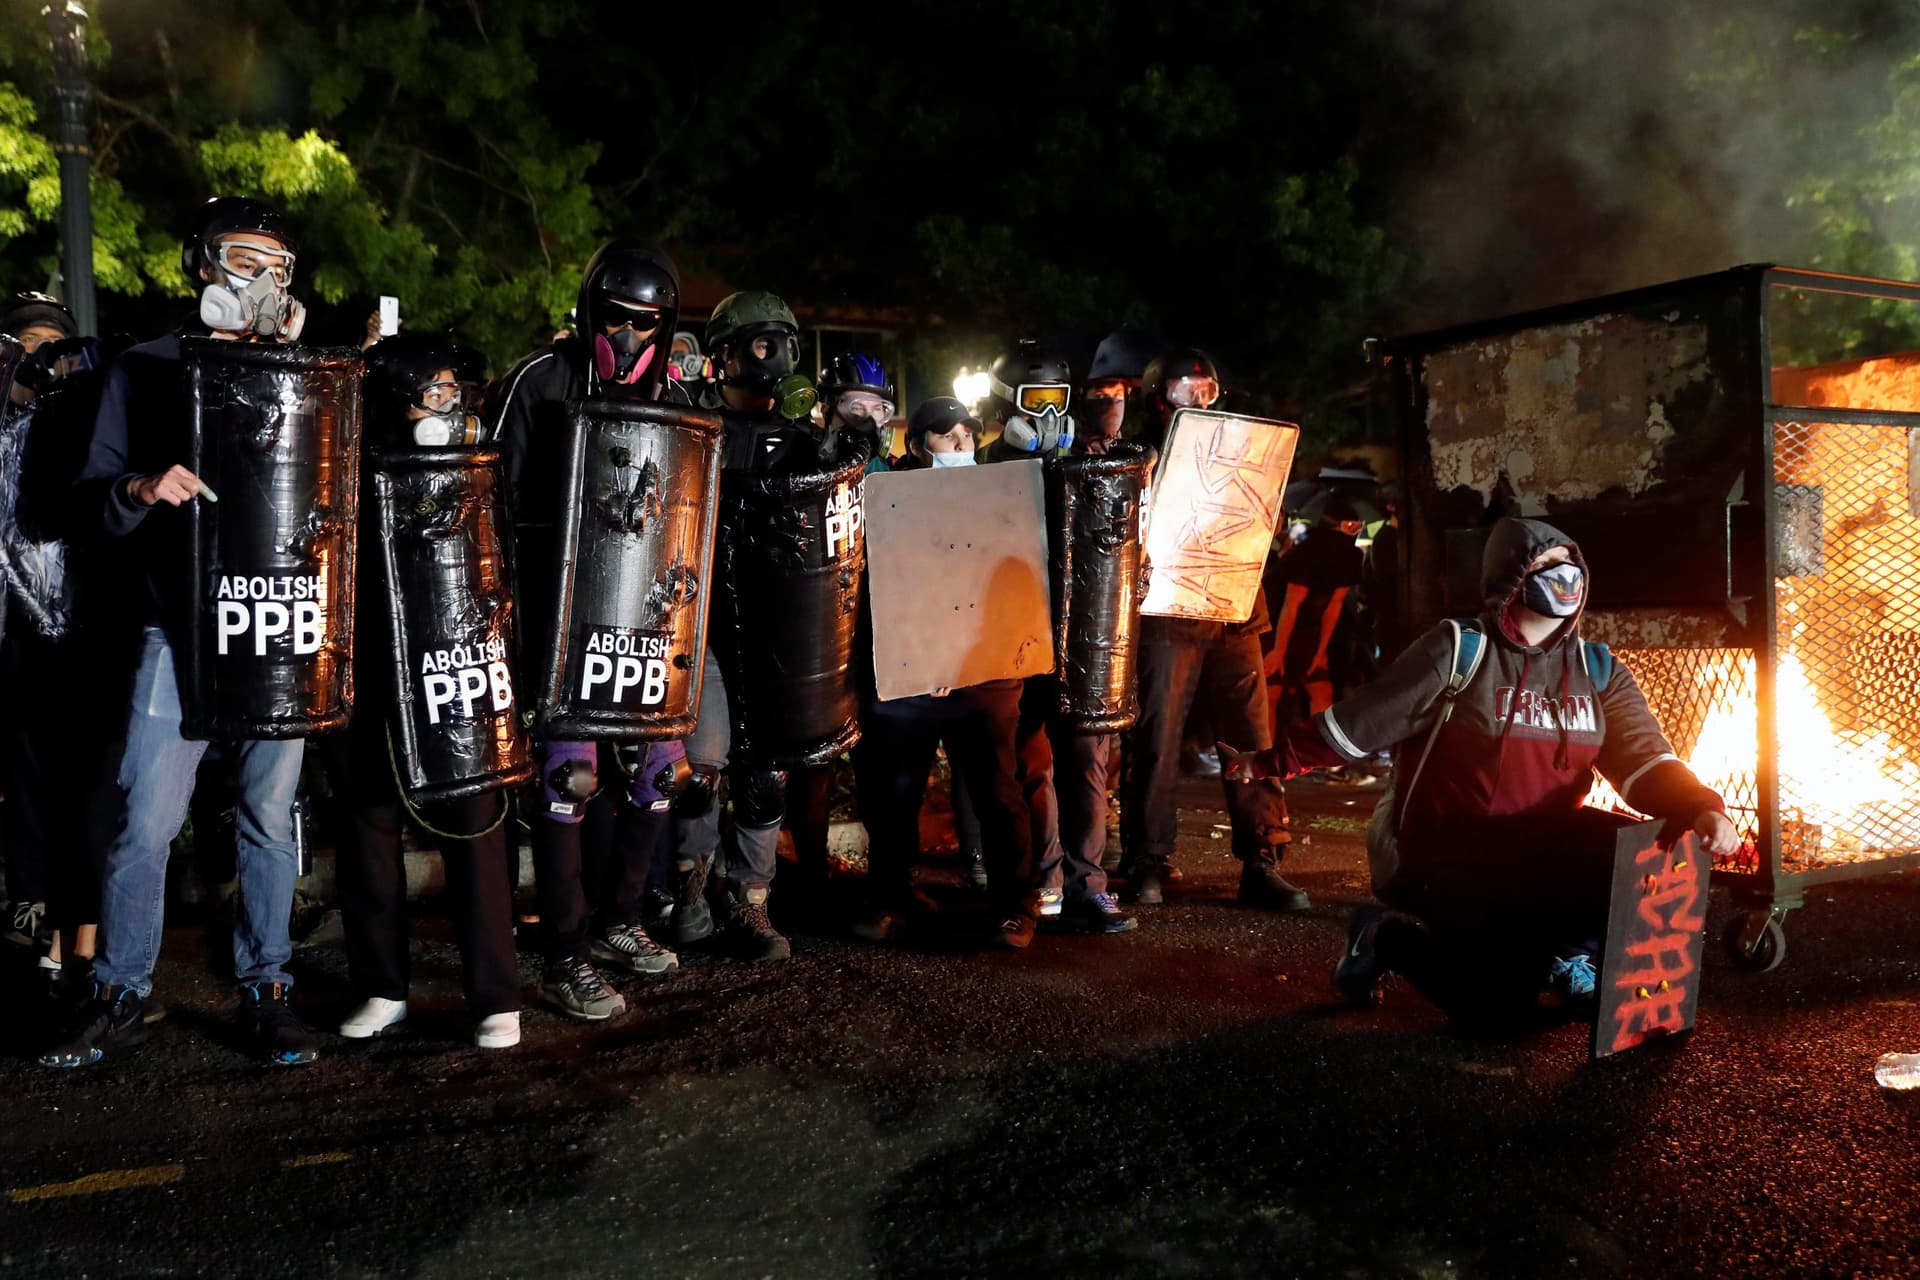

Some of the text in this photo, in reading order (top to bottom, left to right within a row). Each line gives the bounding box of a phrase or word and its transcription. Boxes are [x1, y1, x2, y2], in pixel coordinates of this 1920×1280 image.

[825, 497, 865, 558] PP
[217, 575, 322, 600] ABOLISH
[218, 600, 325, 655] PPB
[586, 632, 671, 658] ABOLISH
[422, 639, 506, 674] ABOLISH
[580, 653, 670, 705] PPB
[423, 662, 514, 725] PPB
